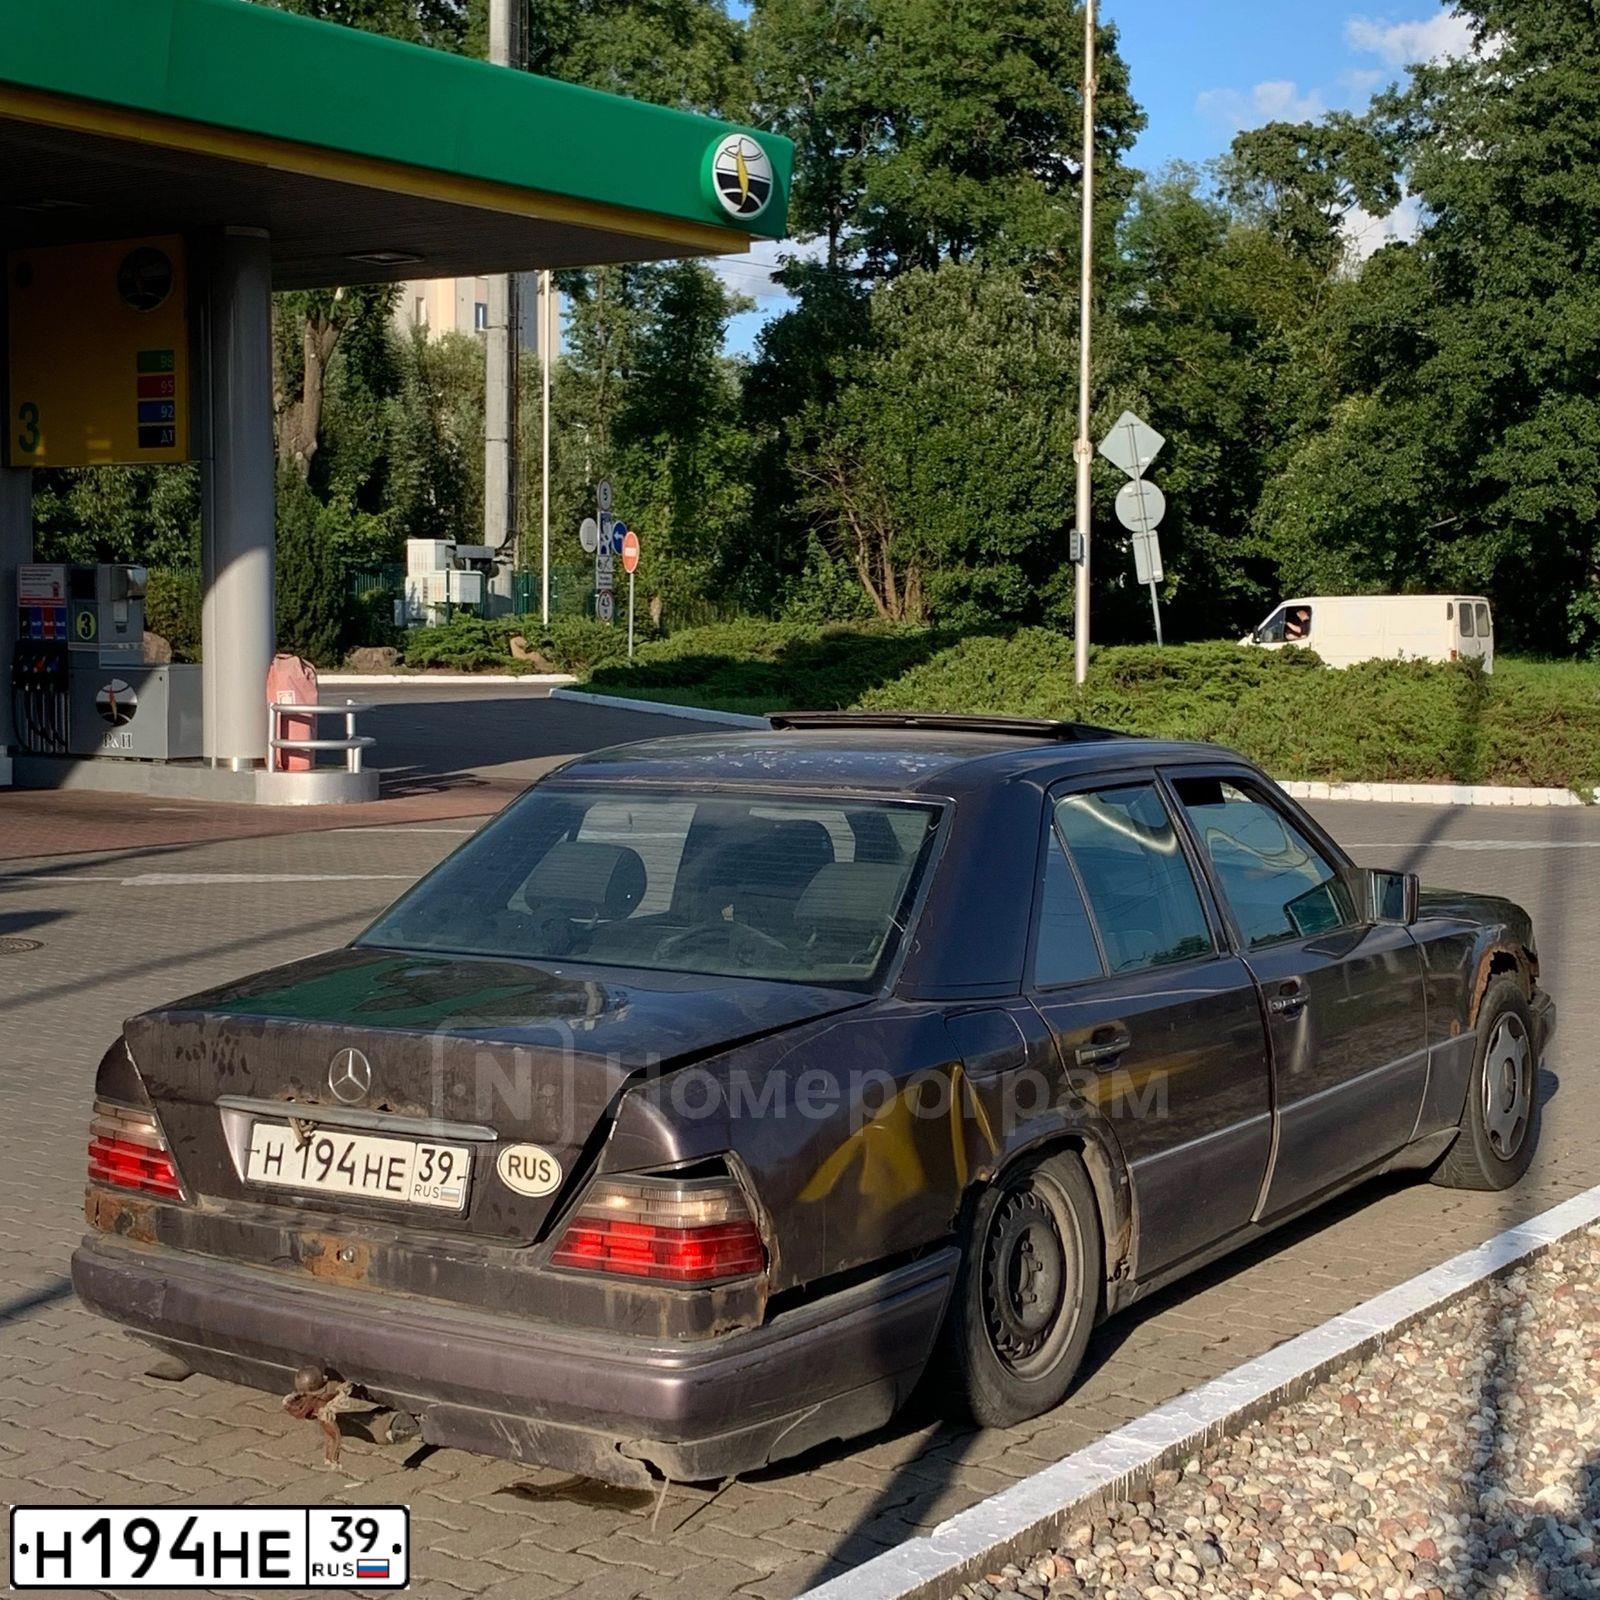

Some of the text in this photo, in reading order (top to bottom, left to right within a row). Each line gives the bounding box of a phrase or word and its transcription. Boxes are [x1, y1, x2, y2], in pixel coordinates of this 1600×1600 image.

[160, 379, 175, 394] 95
[160, 404, 175, 418] 92
[18, 402, 41, 452] 3
[81, 613, 91, 638] 3
[263, 1136, 454, 1192] Н194НЕ 39
[507, 1154, 551, 1183] RUS
[413, 1184, 440, 1199] RUS
